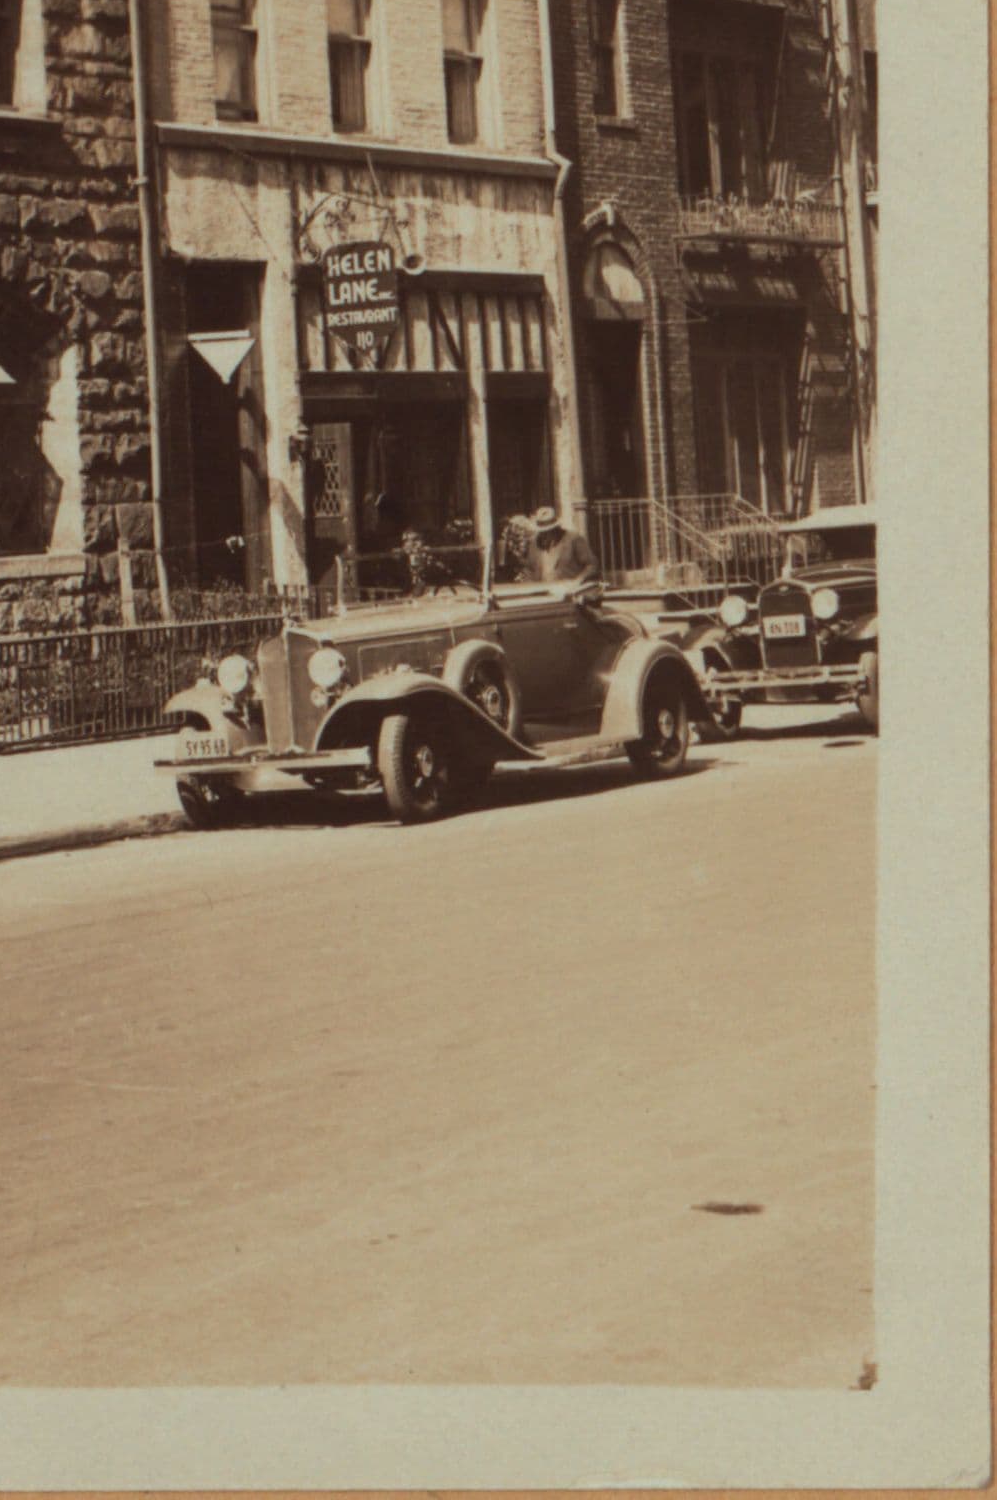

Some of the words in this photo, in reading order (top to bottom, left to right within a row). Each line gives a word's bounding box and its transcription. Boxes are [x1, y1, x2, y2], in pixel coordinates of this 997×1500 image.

[327, 248, 391, 277] HELEN
[329, 278, 379, 306] LANE
[327, 307, 398, 327] RESTAURANT
[357, 331, 374, 350] 110
